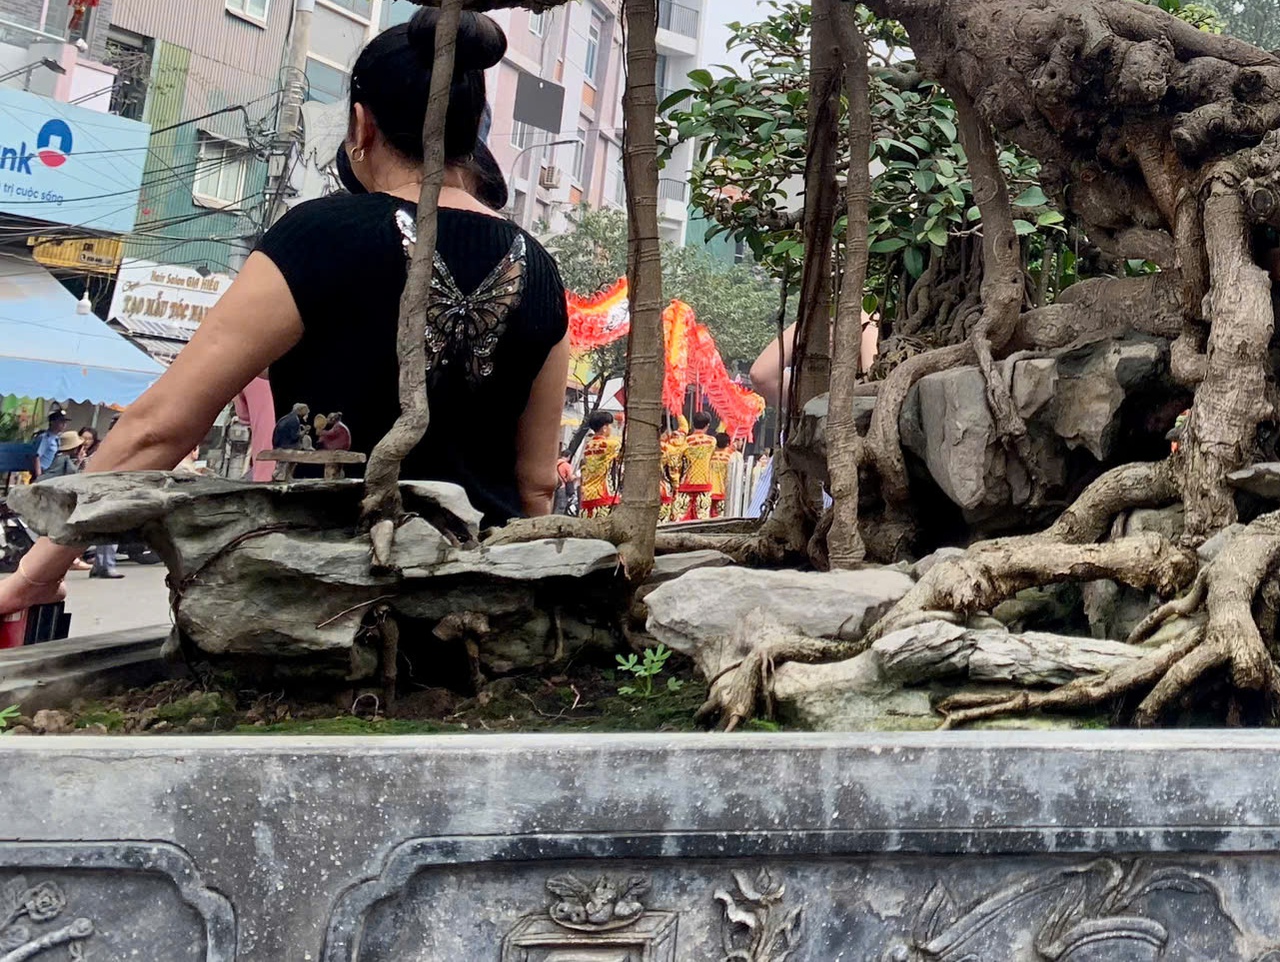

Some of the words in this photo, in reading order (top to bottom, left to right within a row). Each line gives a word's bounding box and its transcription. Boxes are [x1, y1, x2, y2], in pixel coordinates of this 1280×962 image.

[0, 141, 35, 175] nk
[16, 186, 39, 201] cuộc
[41, 190, 64, 206] sống
